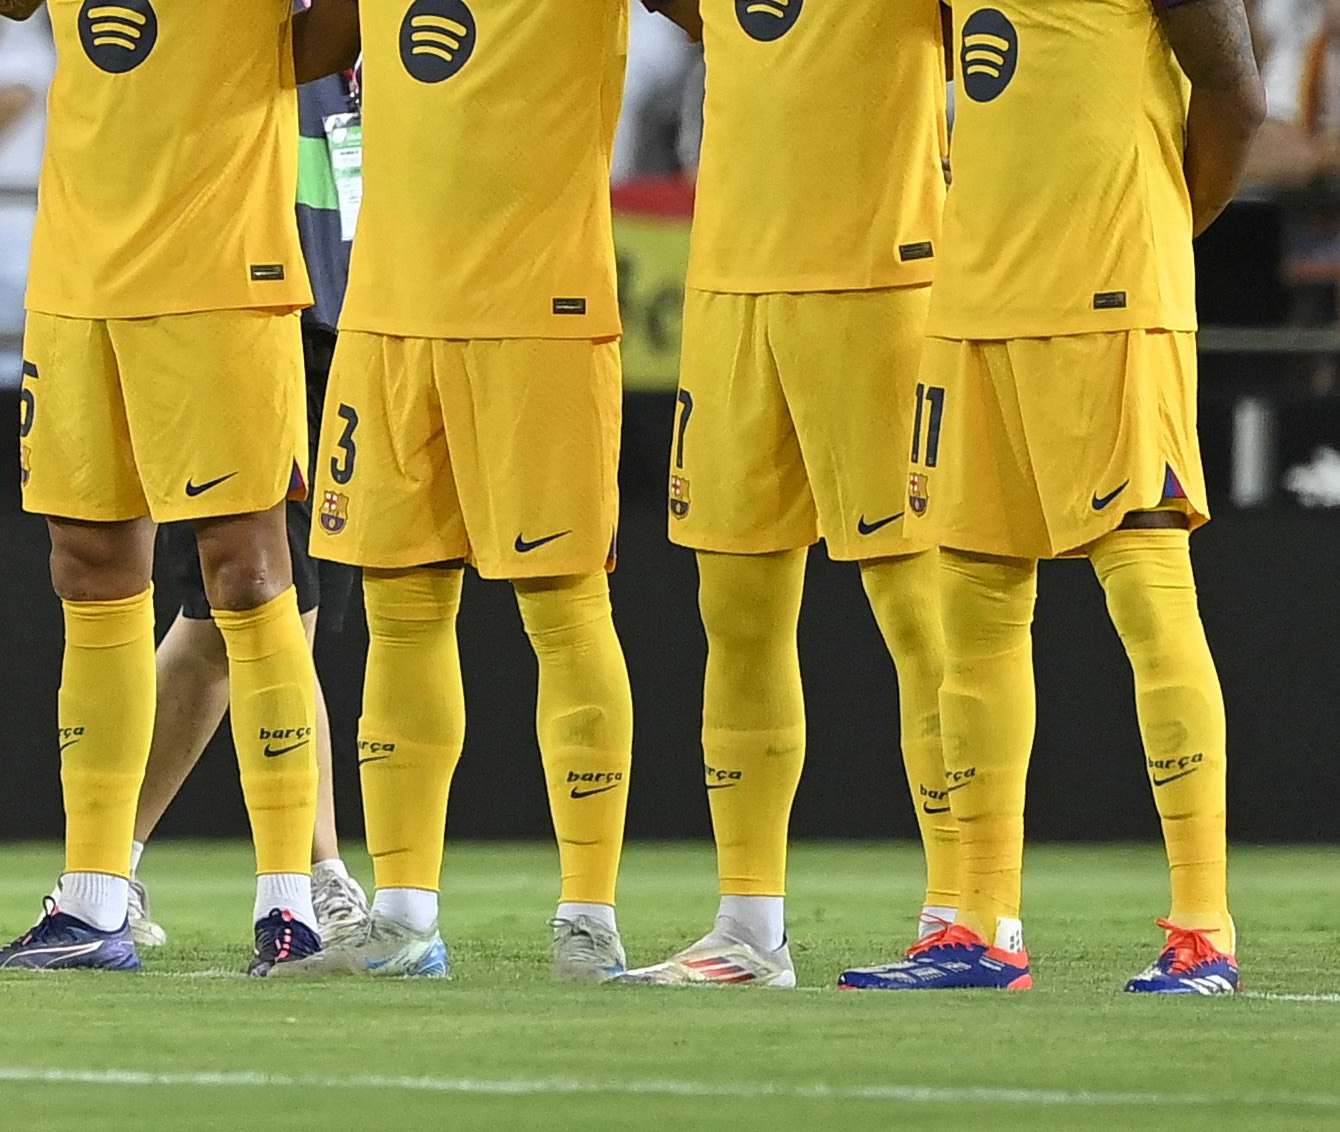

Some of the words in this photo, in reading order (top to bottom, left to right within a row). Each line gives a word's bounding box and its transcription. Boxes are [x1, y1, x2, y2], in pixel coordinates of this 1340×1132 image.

[330, 402, 359, 485] 3
[911, 382, 946, 468] 11
[567, 770, 623, 783] barça
[920, 782, 949, 801] bar
